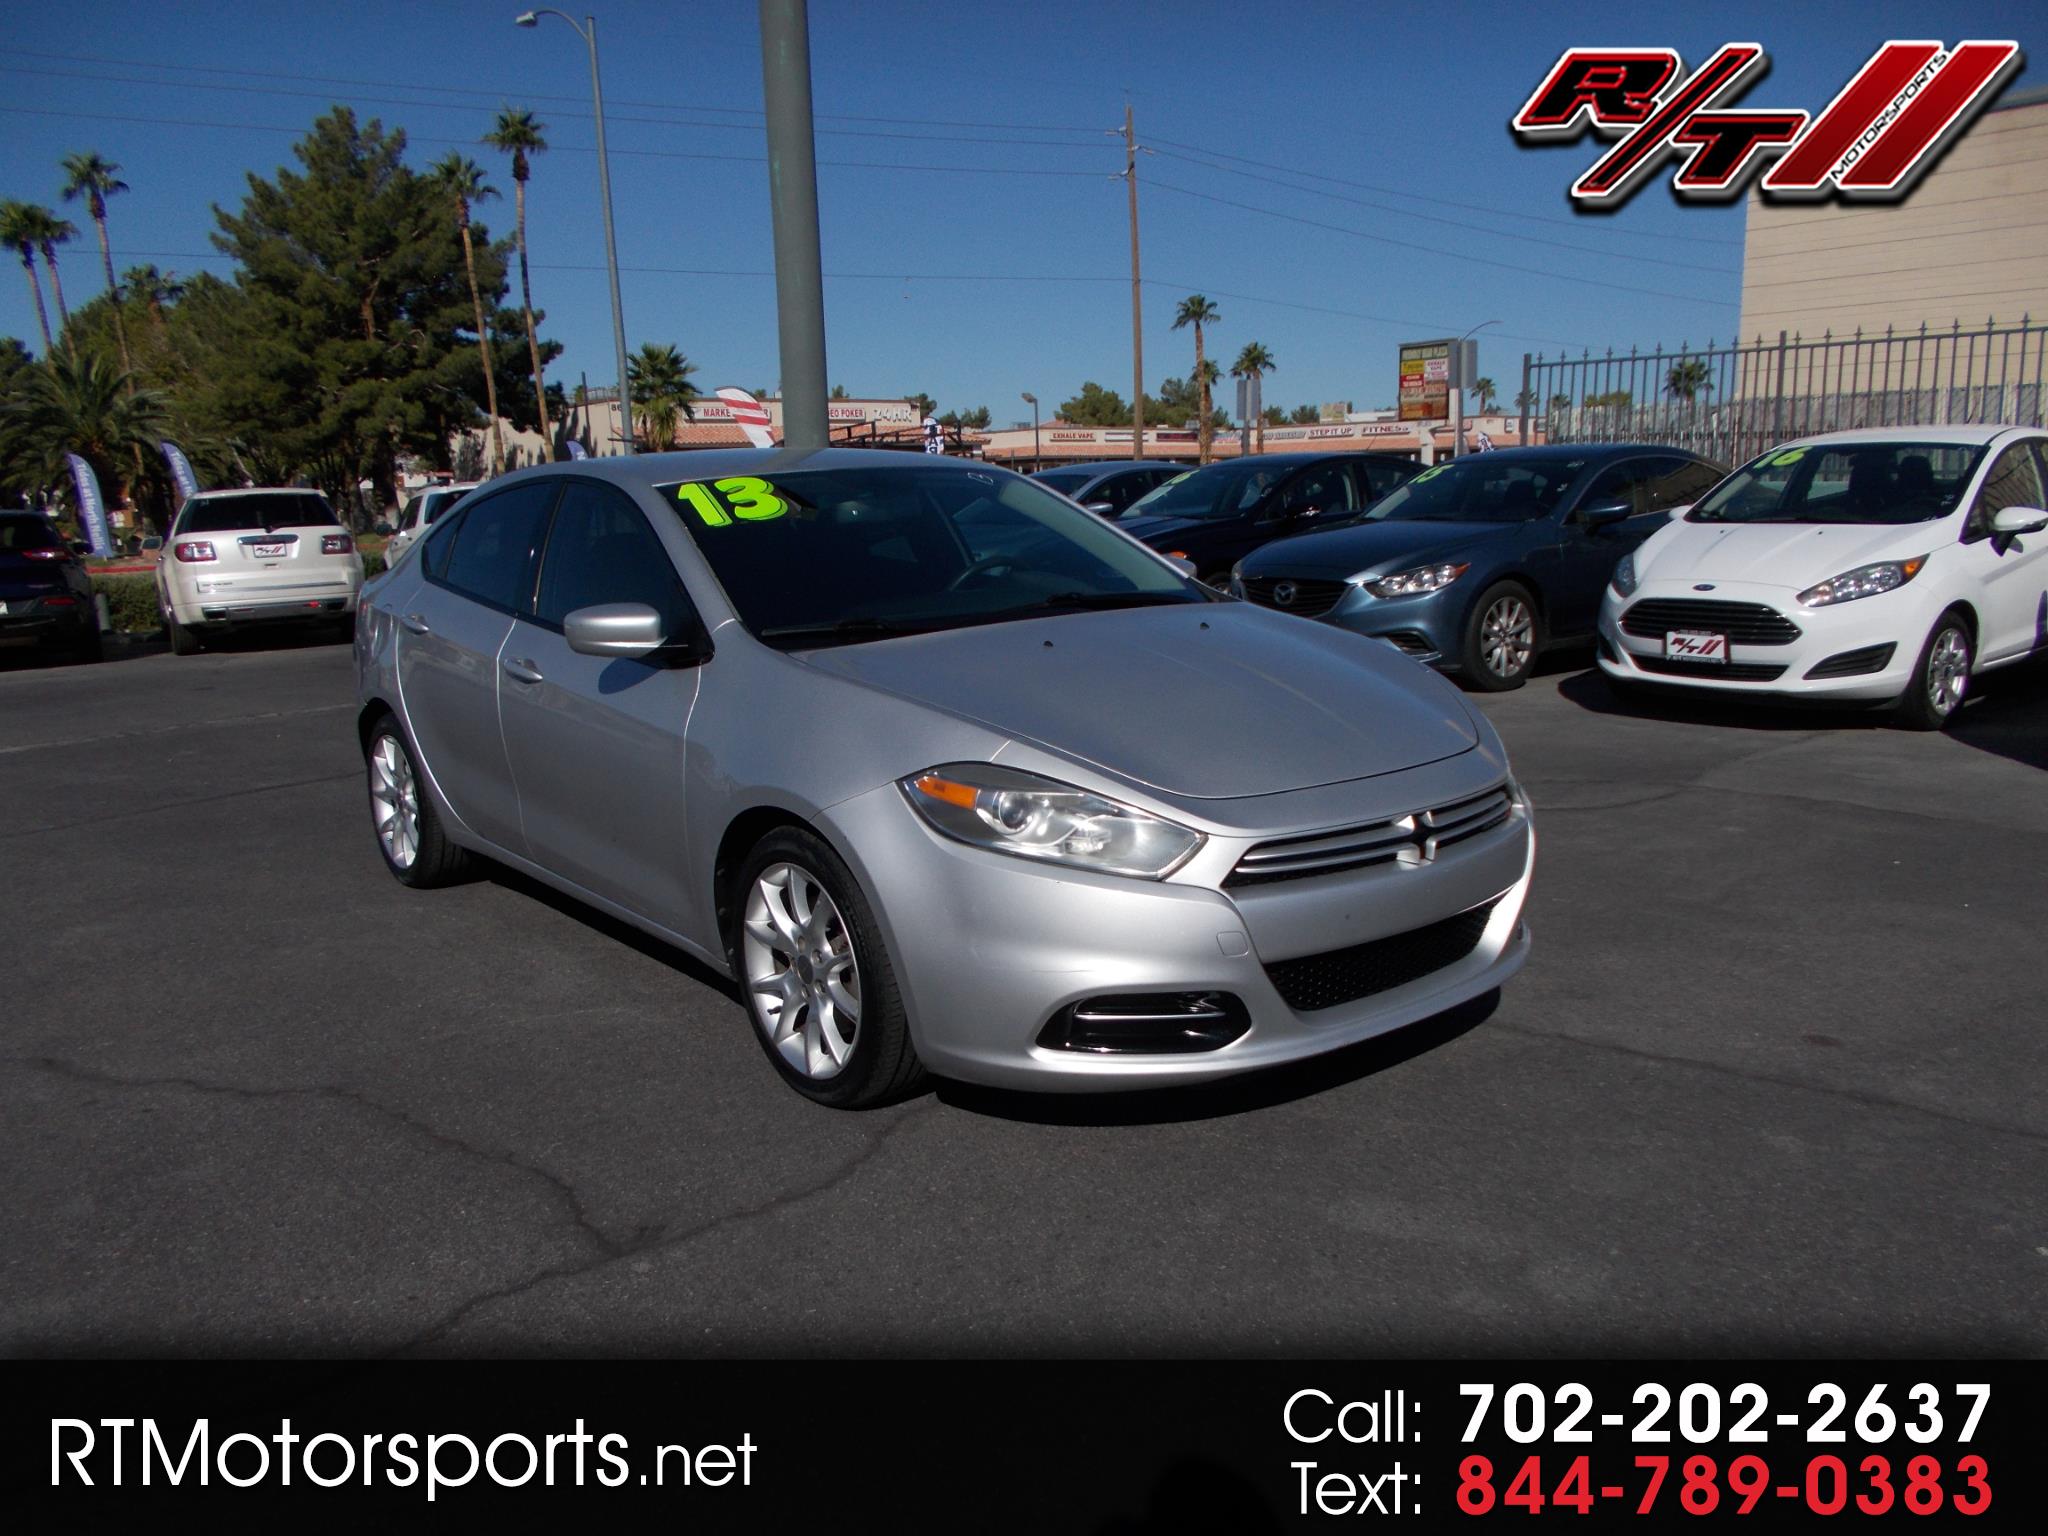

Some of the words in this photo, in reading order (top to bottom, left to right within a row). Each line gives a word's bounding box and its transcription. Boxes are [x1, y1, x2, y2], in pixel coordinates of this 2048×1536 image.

[703, 408, 735, 417] MARKE
[841, 409, 864, 417] POKER
[1310, 429, 1330, 437] STEP
[1340, 427, 1353, 435] UP
[1753, 446, 1813, 469] 16
[677, 475, 789, 527] 13
